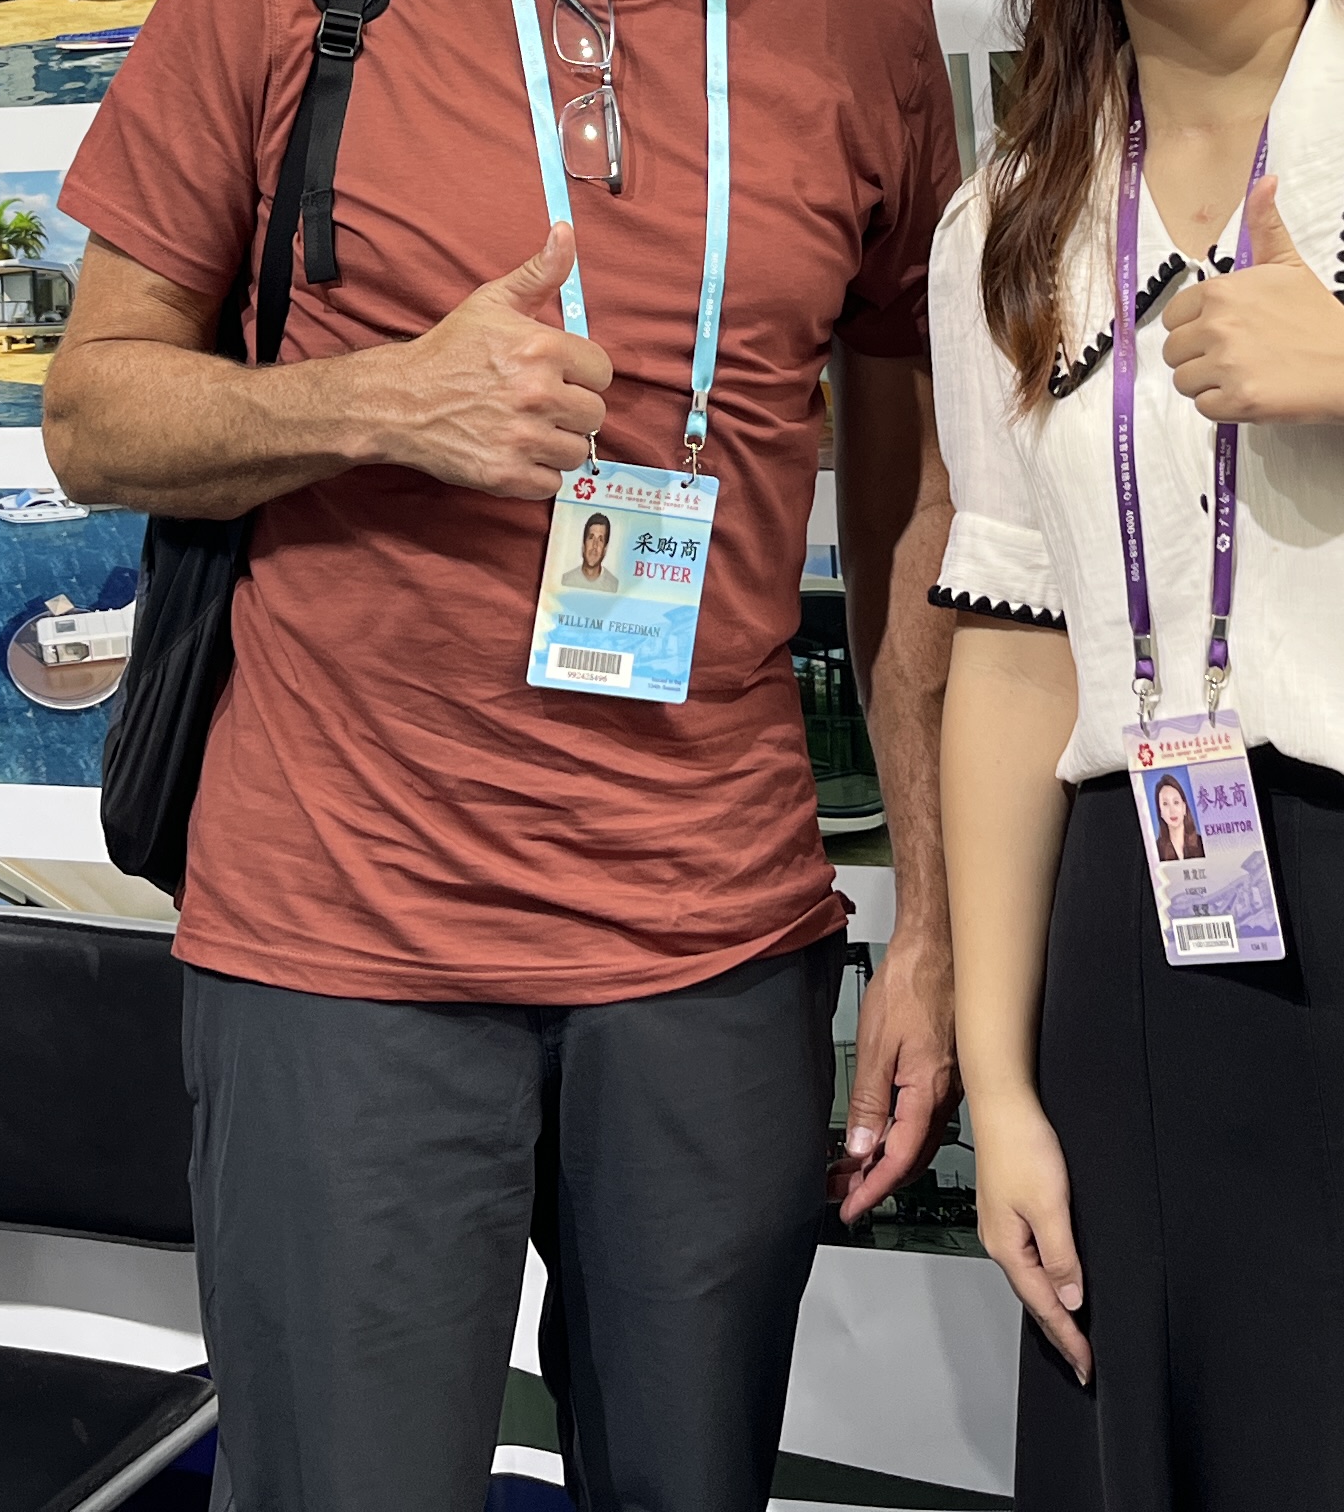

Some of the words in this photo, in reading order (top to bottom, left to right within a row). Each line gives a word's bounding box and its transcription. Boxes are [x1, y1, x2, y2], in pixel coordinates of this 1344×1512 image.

[633, 533, 701, 561] 采购商
[633, 561, 691, 583] BUYER
[558, 614, 603, 630] WILLIAM
[608, 620, 661, 637] FREEDMAN
[1197, 782, 1247, 813] 参展商
[1205, 819, 1253, 836] EXHIBITOR
